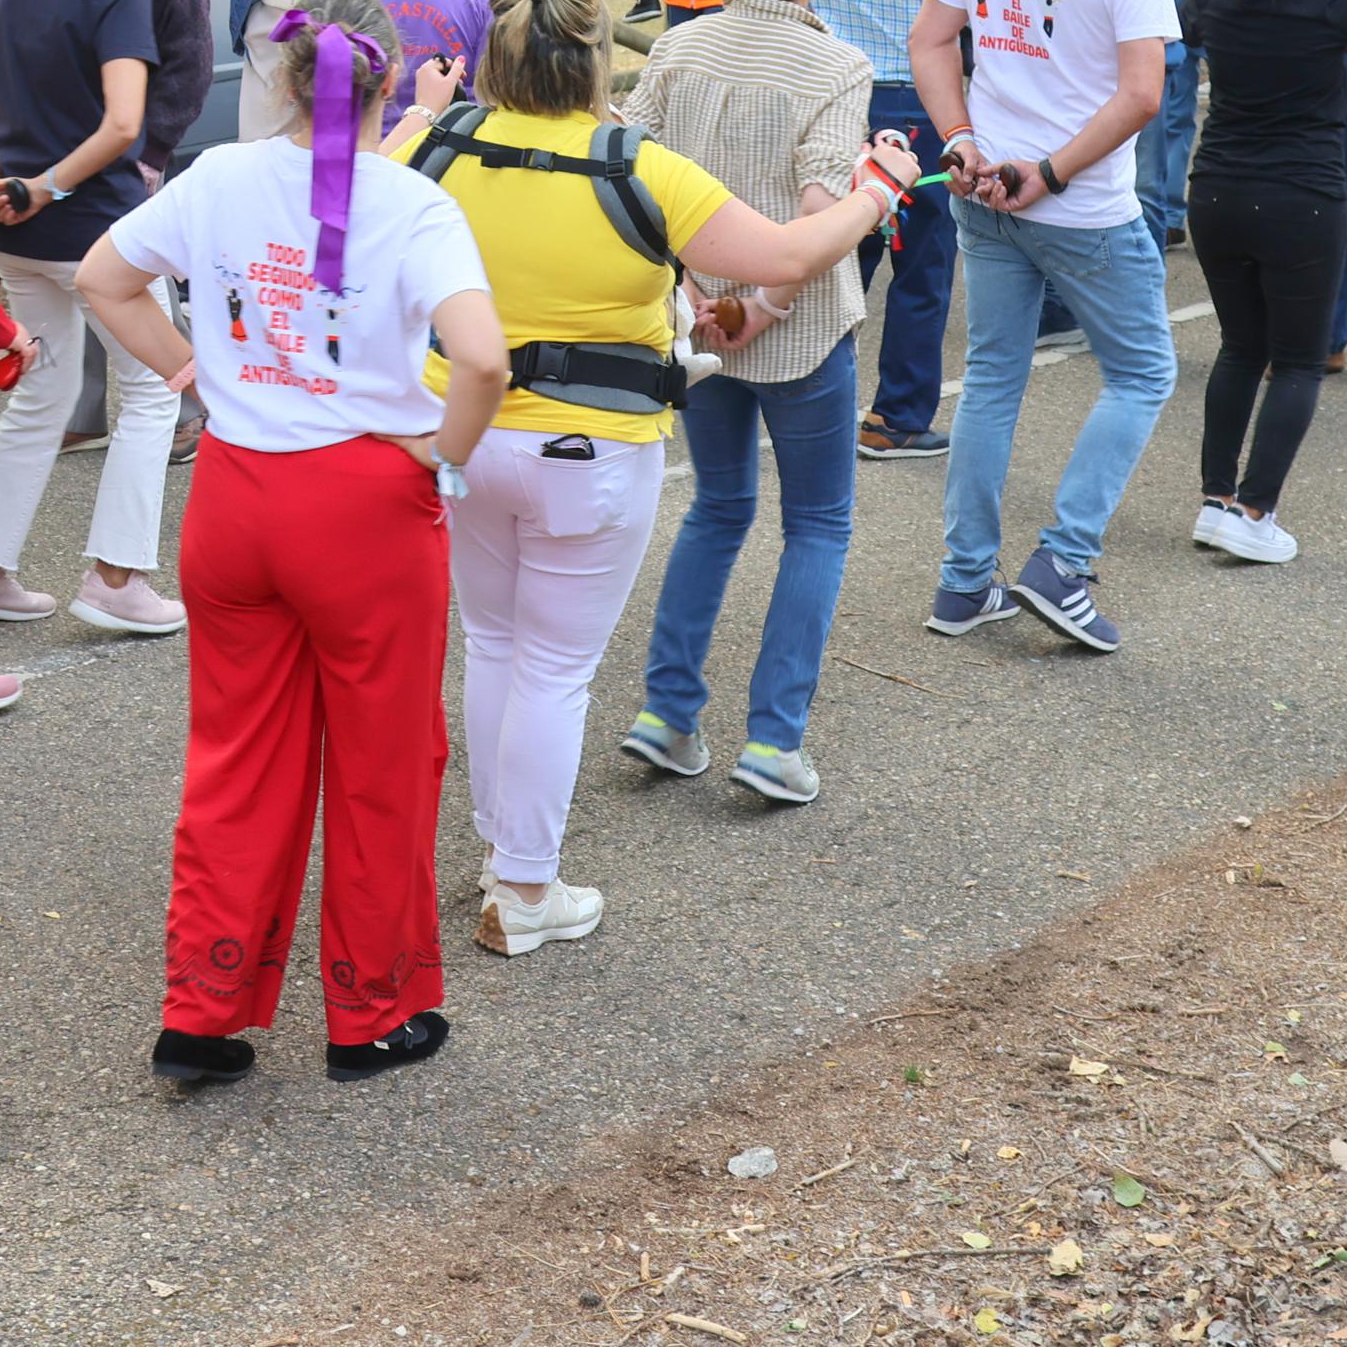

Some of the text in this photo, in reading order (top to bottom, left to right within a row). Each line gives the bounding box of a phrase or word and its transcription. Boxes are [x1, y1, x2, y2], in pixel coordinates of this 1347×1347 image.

[1003, 9, 1031, 28] BAILE
[1011, 25, 1024, 40] DE
[978, 35, 1050, 60] ANTIGÜEDAD
[267, 242, 306, 267] TODO
[247, 262, 317, 291] SEGUIDO
[258, 287, 304, 311] COMO
[269, 311, 291, 330] EL
